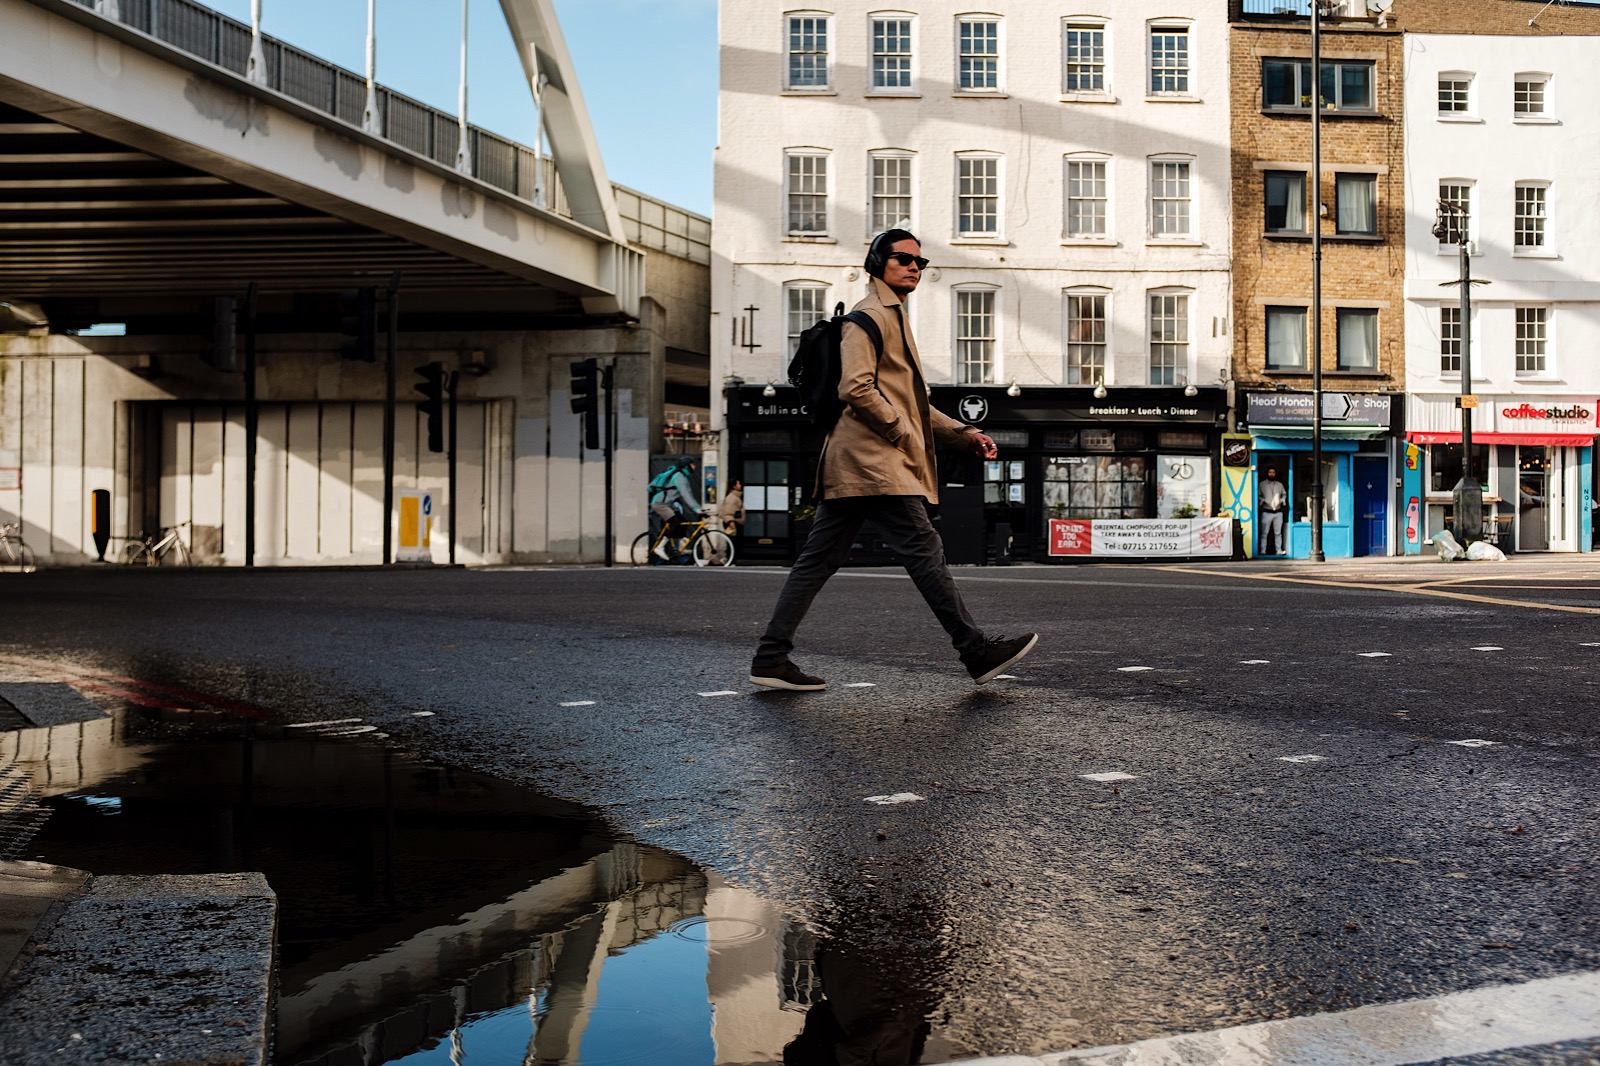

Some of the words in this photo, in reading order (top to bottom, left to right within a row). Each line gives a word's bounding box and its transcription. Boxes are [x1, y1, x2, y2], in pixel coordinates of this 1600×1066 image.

[1250, 396, 1277, 406] Head
[1364, 398, 1389, 409] Shop
[758, 405, 777, 415] Bull
[779, 406, 788, 414] in
[1089, 406, 1128, 415] Breakfast
[1138, 407, 1162, 416] Lunch
[1170, 407, 1198, 415] Dinner
[1502, 404, 1590, 419] coffeestudio
[1062, 532, 1077, 540] TOO
[1143, 531, 1180, 539] DELIVERIES
[1057, 540, 1083, 549] EARLY
[1104, 542, 1116, 550] Tel
[1122, 542, 1147, 550] 07715
[1149, 542, 1178, 550] 217652
